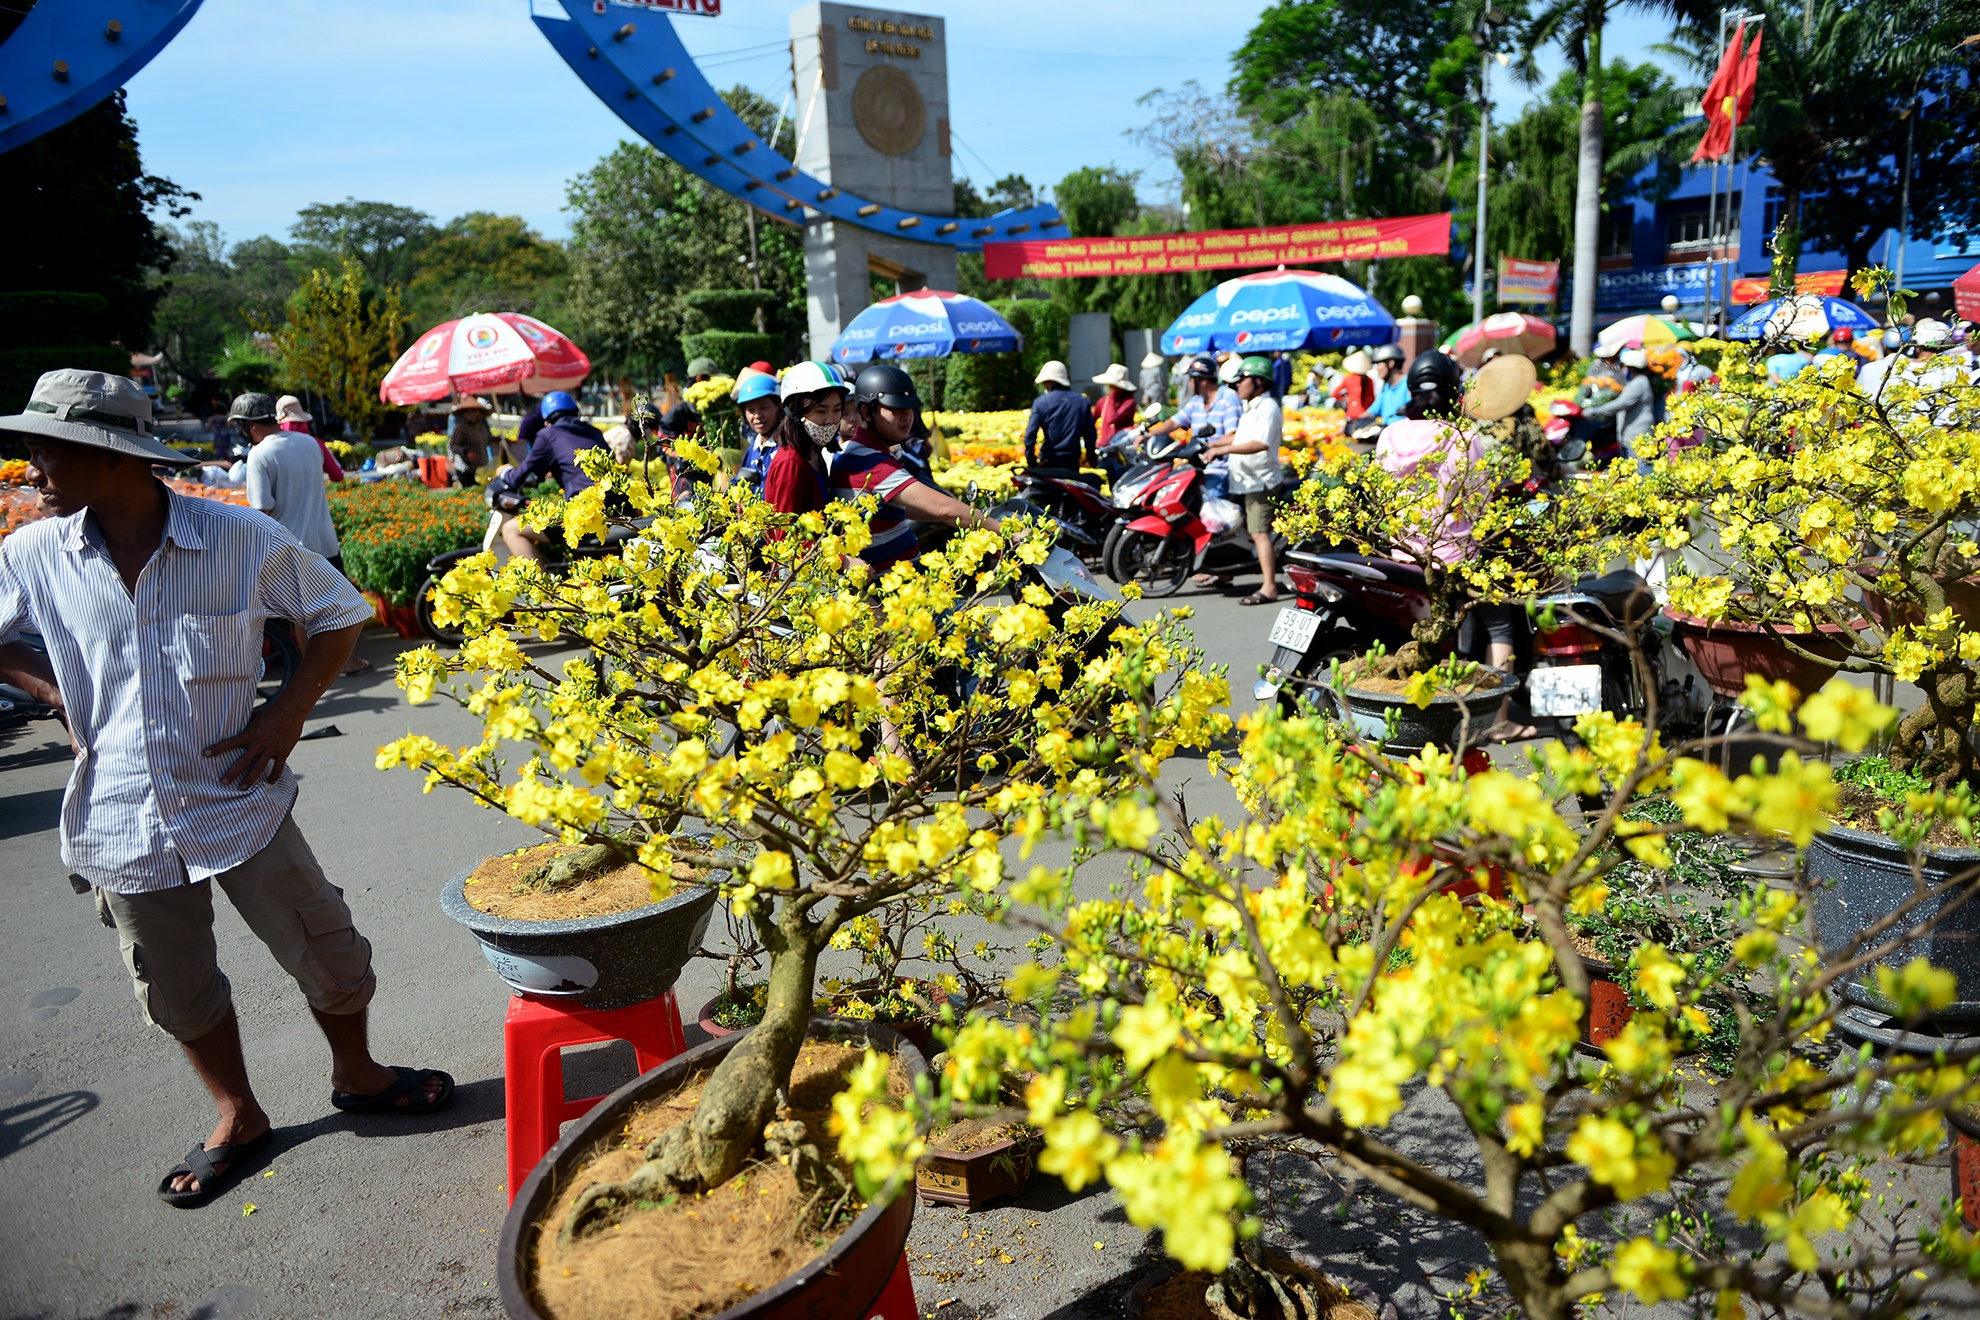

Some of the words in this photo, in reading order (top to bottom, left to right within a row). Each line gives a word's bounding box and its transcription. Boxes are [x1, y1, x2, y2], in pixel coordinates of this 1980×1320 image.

[1089, 241, 1127, 256] XUÂN
[1290, 228, 1340, 244] QUANG
[1065, 259, 1112, 273] THÀNH
[1114, 254, 1144, 271] PHỐ
[1147, 253, 1168, 269] HỒ
[1170, 253, 1195, 268] CHÍ
[1198, 252, 1235, 265] MINH
[1278, 245, 1308, 260] LÊN
[1598, 267, 1717, 289] Bookstore
[1177, 312, 1219, 329] pepsi
[1231, 305, 1296, 326] pepsi
[1315, 301, 1371, 322] pepsi
[889, 321, 942, 338] pepsi
[957, 318, 1001, 335] pepsi
[1283, 611, 1312, 632] 59-U1
[1272, 626, 1310, 650] 879.07
